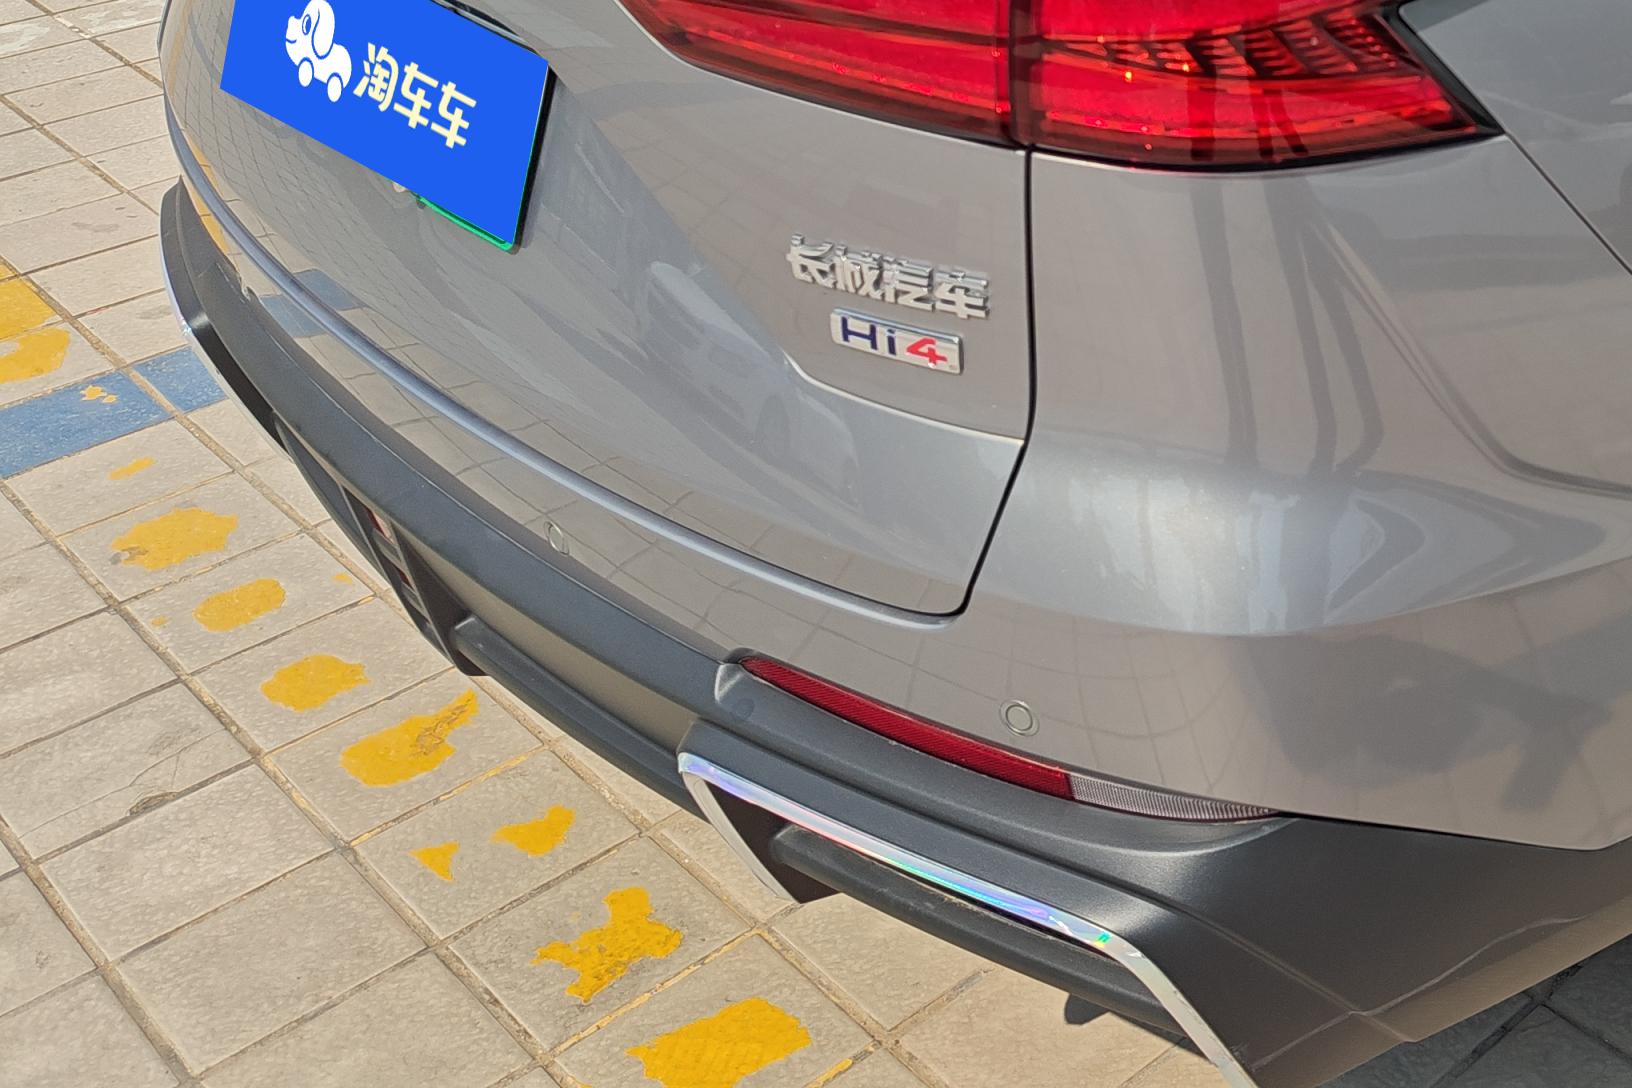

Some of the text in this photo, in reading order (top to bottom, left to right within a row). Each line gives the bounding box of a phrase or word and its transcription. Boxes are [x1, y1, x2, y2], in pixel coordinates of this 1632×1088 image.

[786, 233, 991, 320] 长城汽车
[840, 315, 949, 369] Hi4
